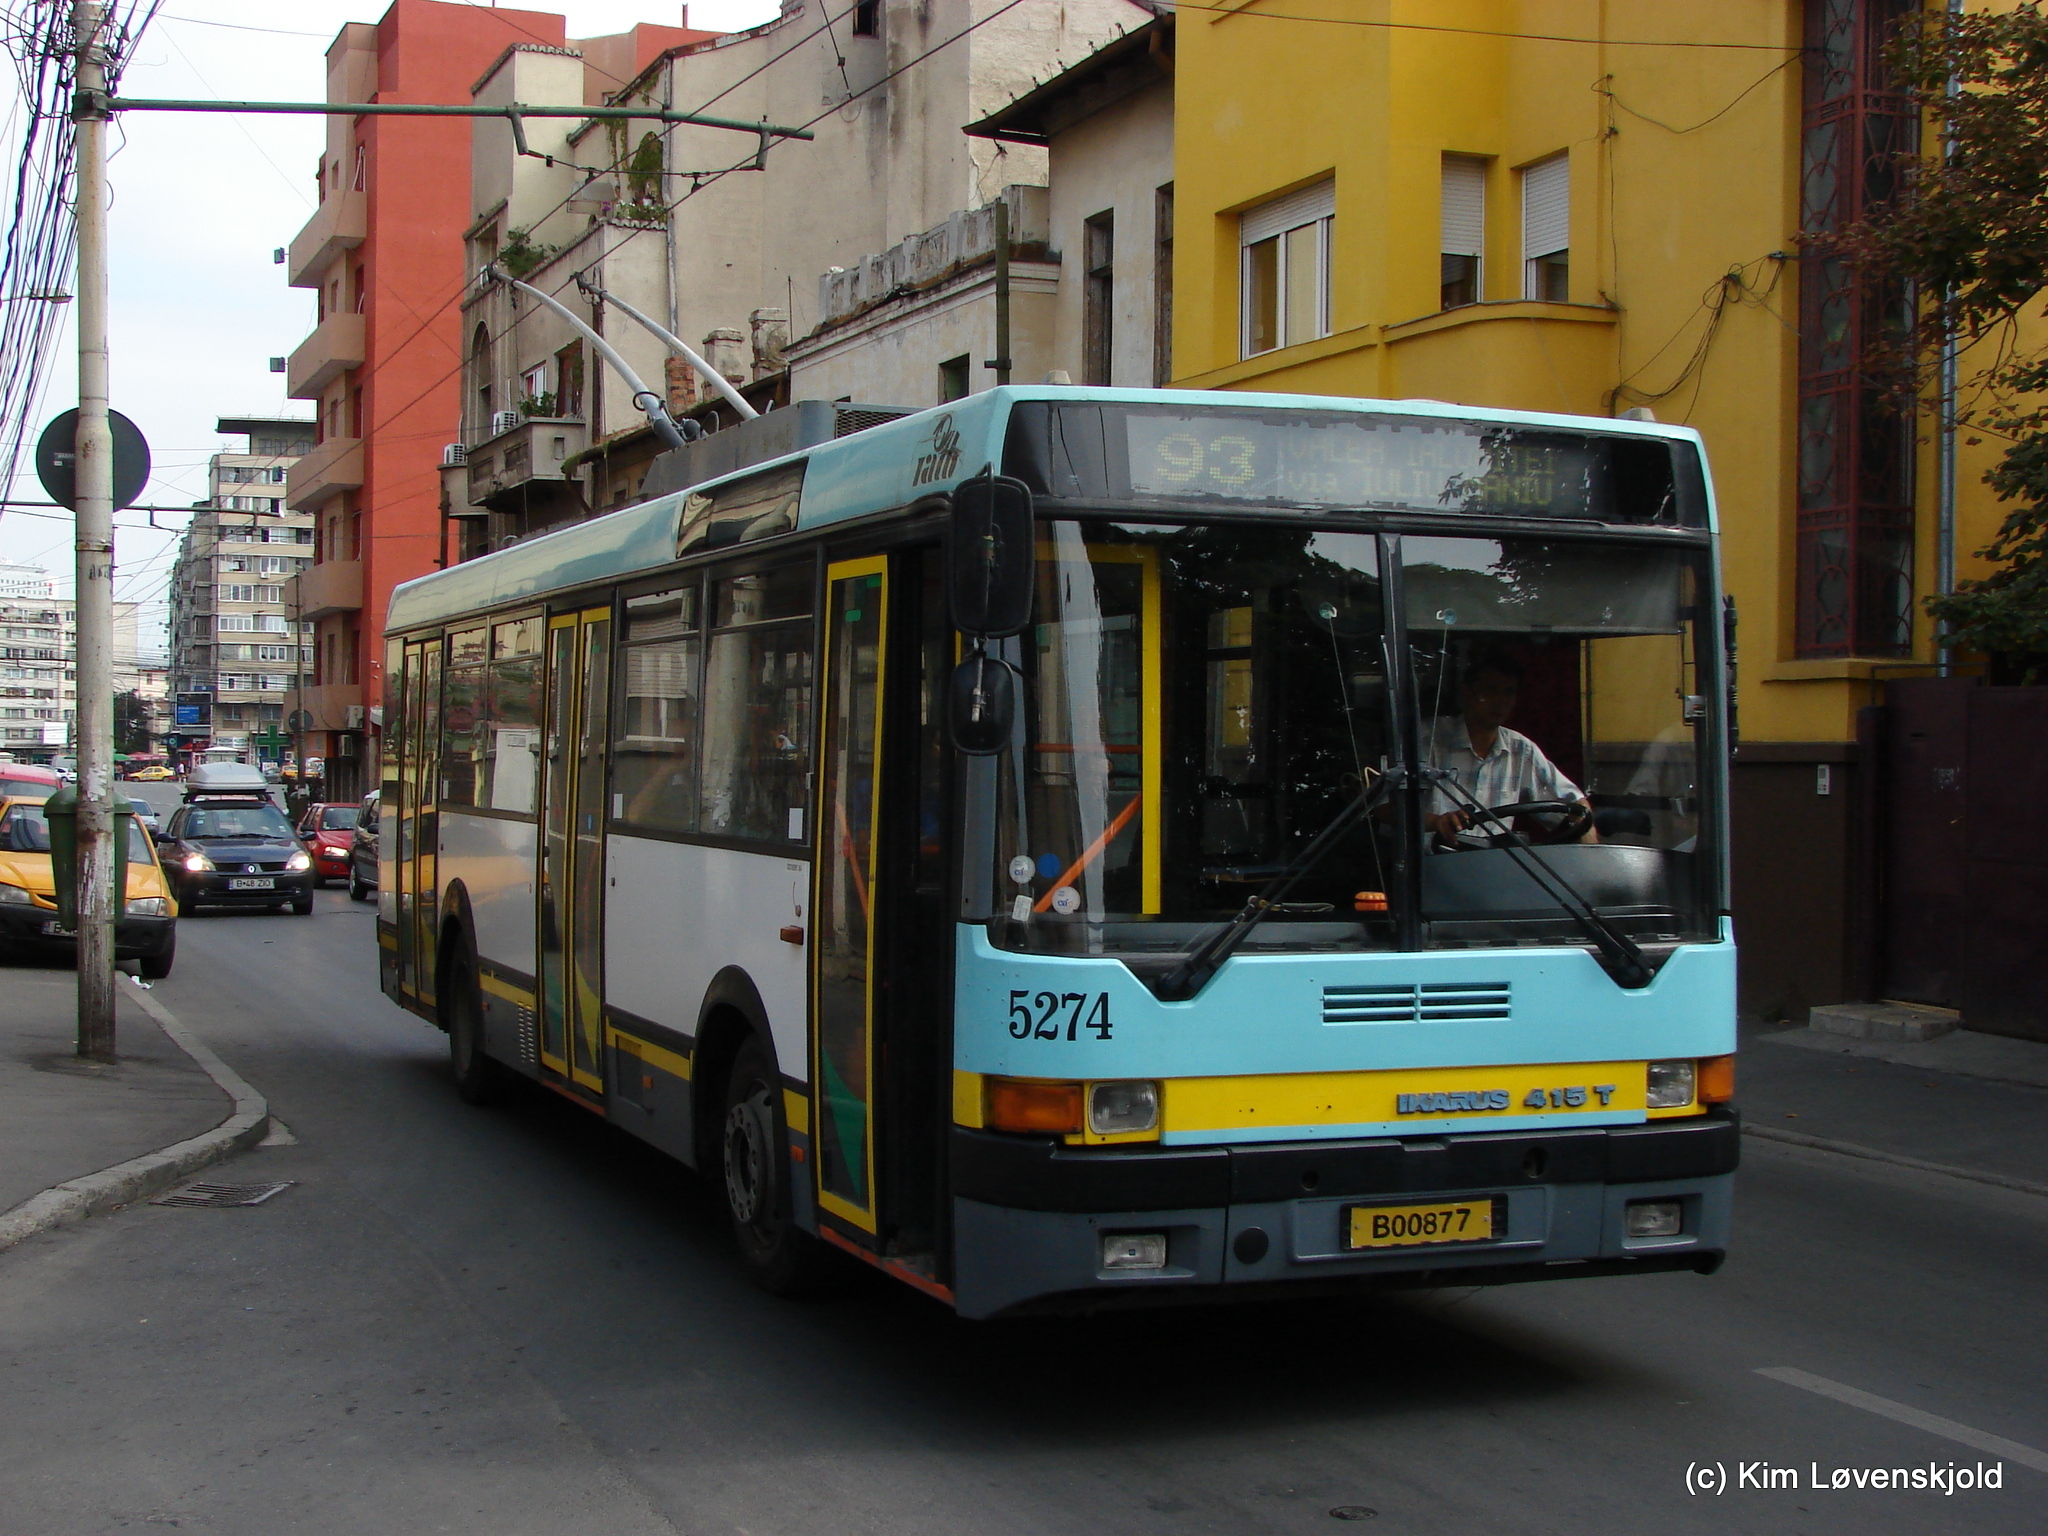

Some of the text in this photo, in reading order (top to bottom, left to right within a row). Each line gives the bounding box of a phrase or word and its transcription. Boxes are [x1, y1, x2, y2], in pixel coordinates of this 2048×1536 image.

[1156, 433, 1257, 485] 93
[1288, 438, 1555, 474] VALEA IALOITEI
[1008, 989, 1114, 1041] 5274
[1397, 1084, 1616, 1115] IKARUS 415 T
[1372, 1208, 1471, 1239] B00877
